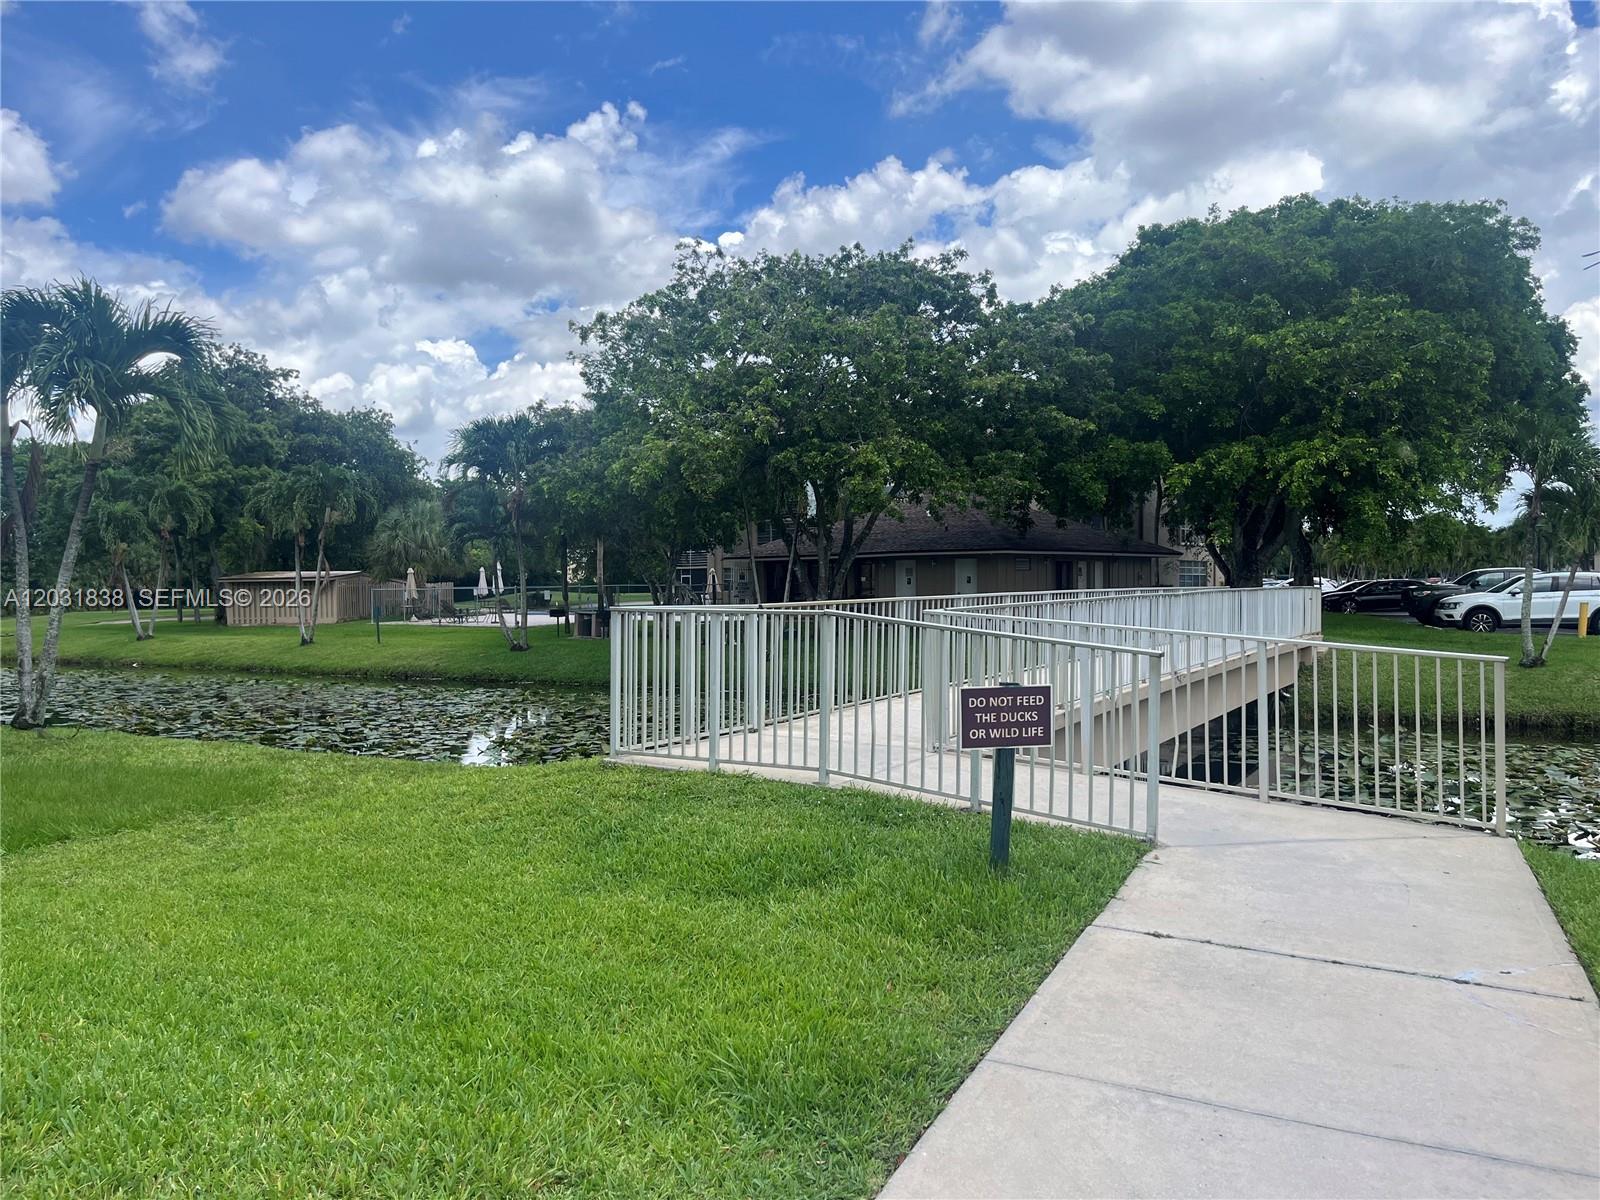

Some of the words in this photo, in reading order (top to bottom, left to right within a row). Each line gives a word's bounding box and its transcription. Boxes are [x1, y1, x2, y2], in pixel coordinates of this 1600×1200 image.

[968, 698, 986, 708] DO
[989, 696, 1013, 707] NOT
[1016, 695, 1044, 706] FEED
[975, 713, 997, 723] THE
[1000, 711, 1038, 722] DUCKS
[969, 729, 986, 739] OR
[989, 727, 1019, 738] WILD
[1022, 726, 1044, 737] LIFE
